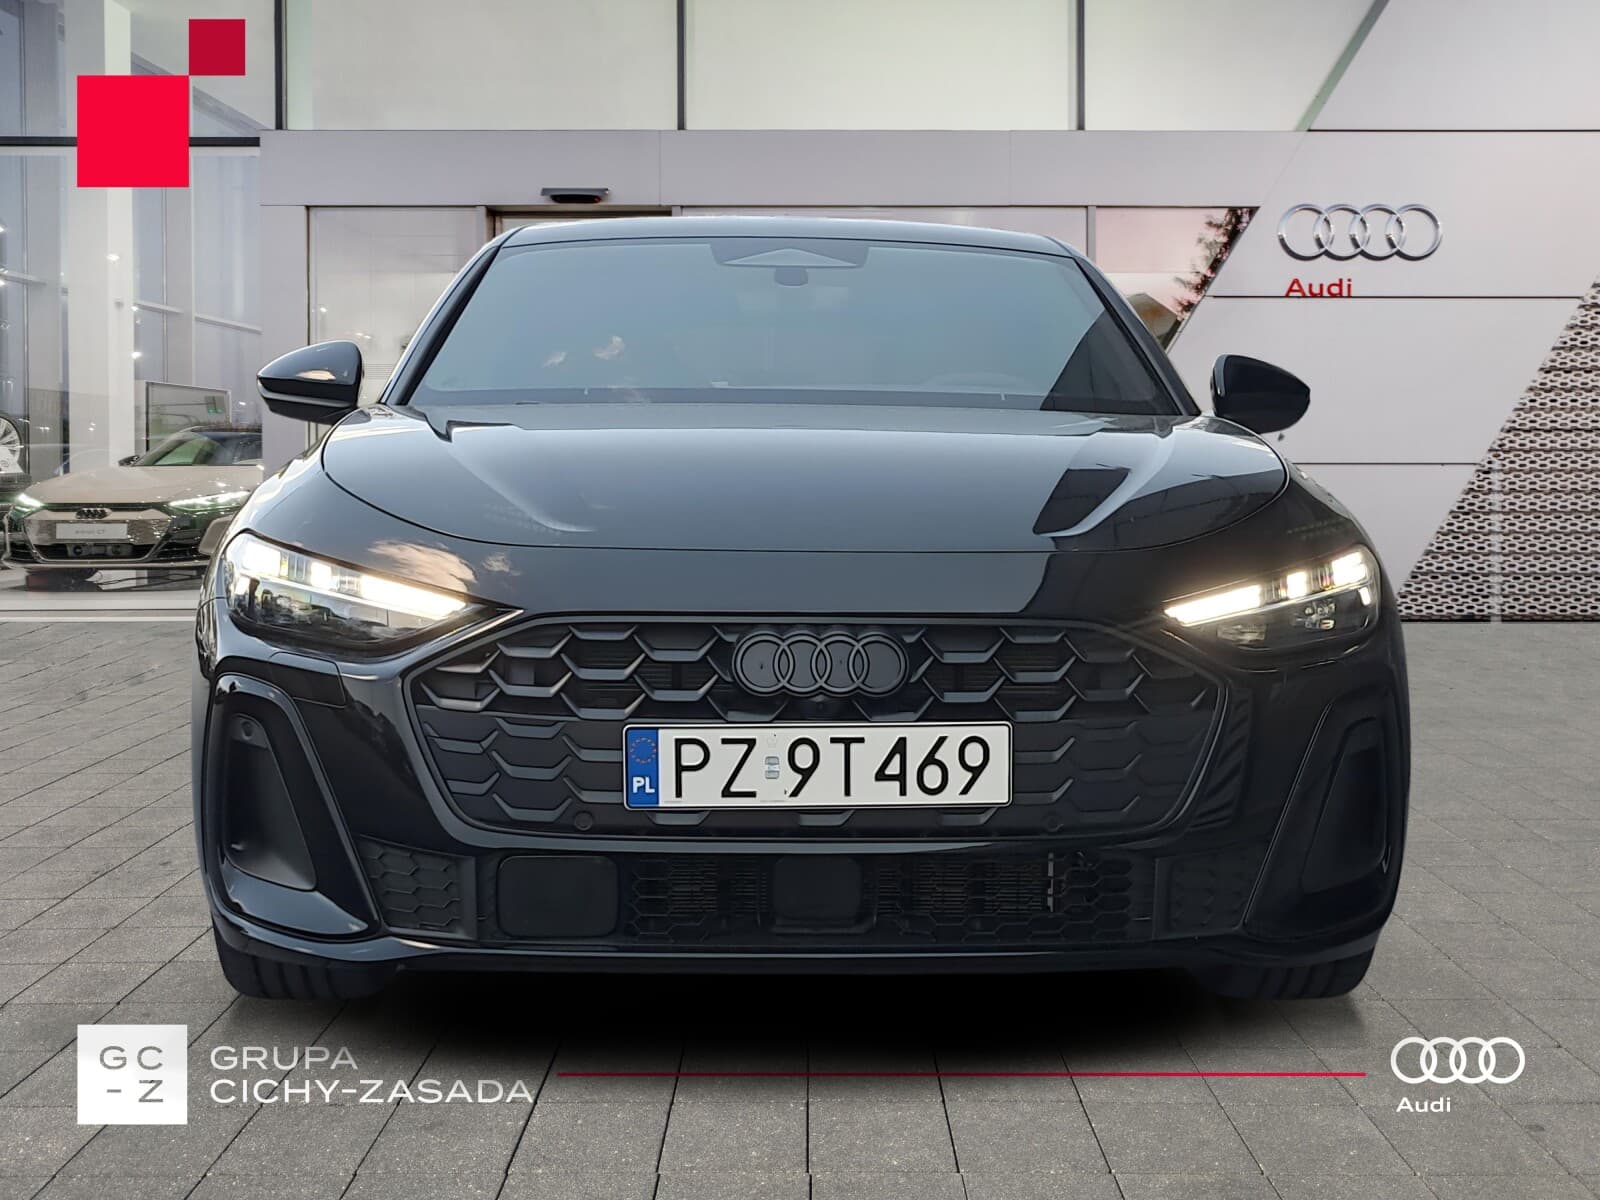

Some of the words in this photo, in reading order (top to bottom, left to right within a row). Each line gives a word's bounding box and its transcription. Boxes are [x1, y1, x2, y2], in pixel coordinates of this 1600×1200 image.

[1285, 278, 1352, 298] Audi
[673, 737, 757, 798] PZ
[786, 735, 991, 798] 9T469
[632, 776, 656, 793] PL
